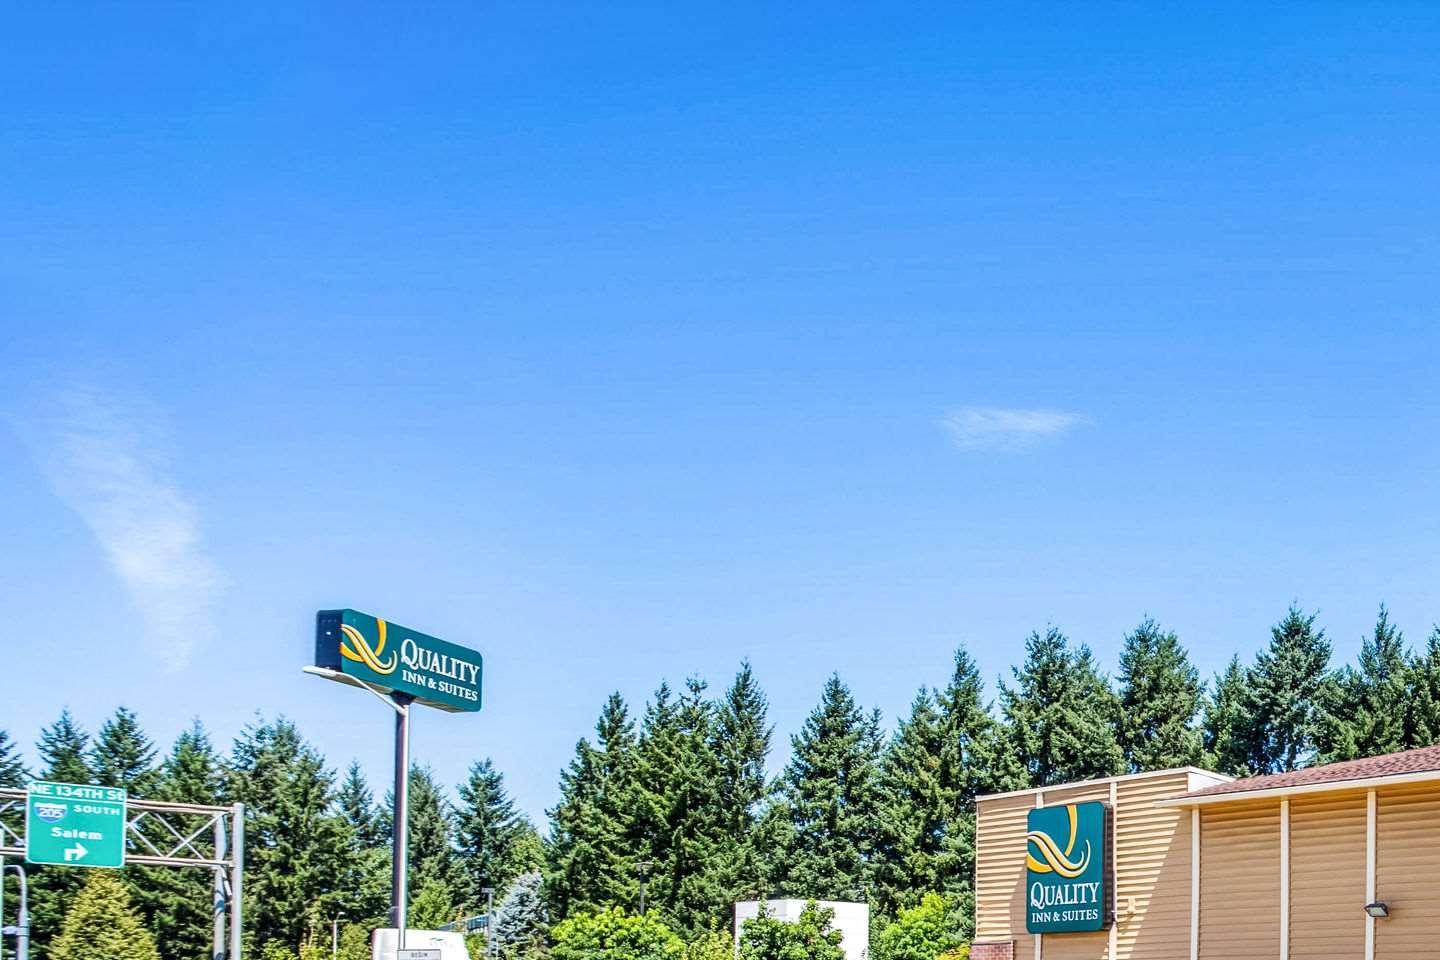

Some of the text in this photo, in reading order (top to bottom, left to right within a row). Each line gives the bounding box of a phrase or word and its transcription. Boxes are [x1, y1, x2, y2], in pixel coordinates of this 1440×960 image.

[401, 638, 480, 685] QUALITY
[402, 669, 478, 701] INN & SUITES
[31, 784, 53, 795] NE
[56, 786, 103, 799] 134TH
[40, 807, 64, 818] 205
[73, 804, 120, 816] SOUTH
[50, 826, 103, 840] Salem
[1030, 881, 1100, 910] QUALITY
[1032, 909, 1098, 923] INN & SUITES
